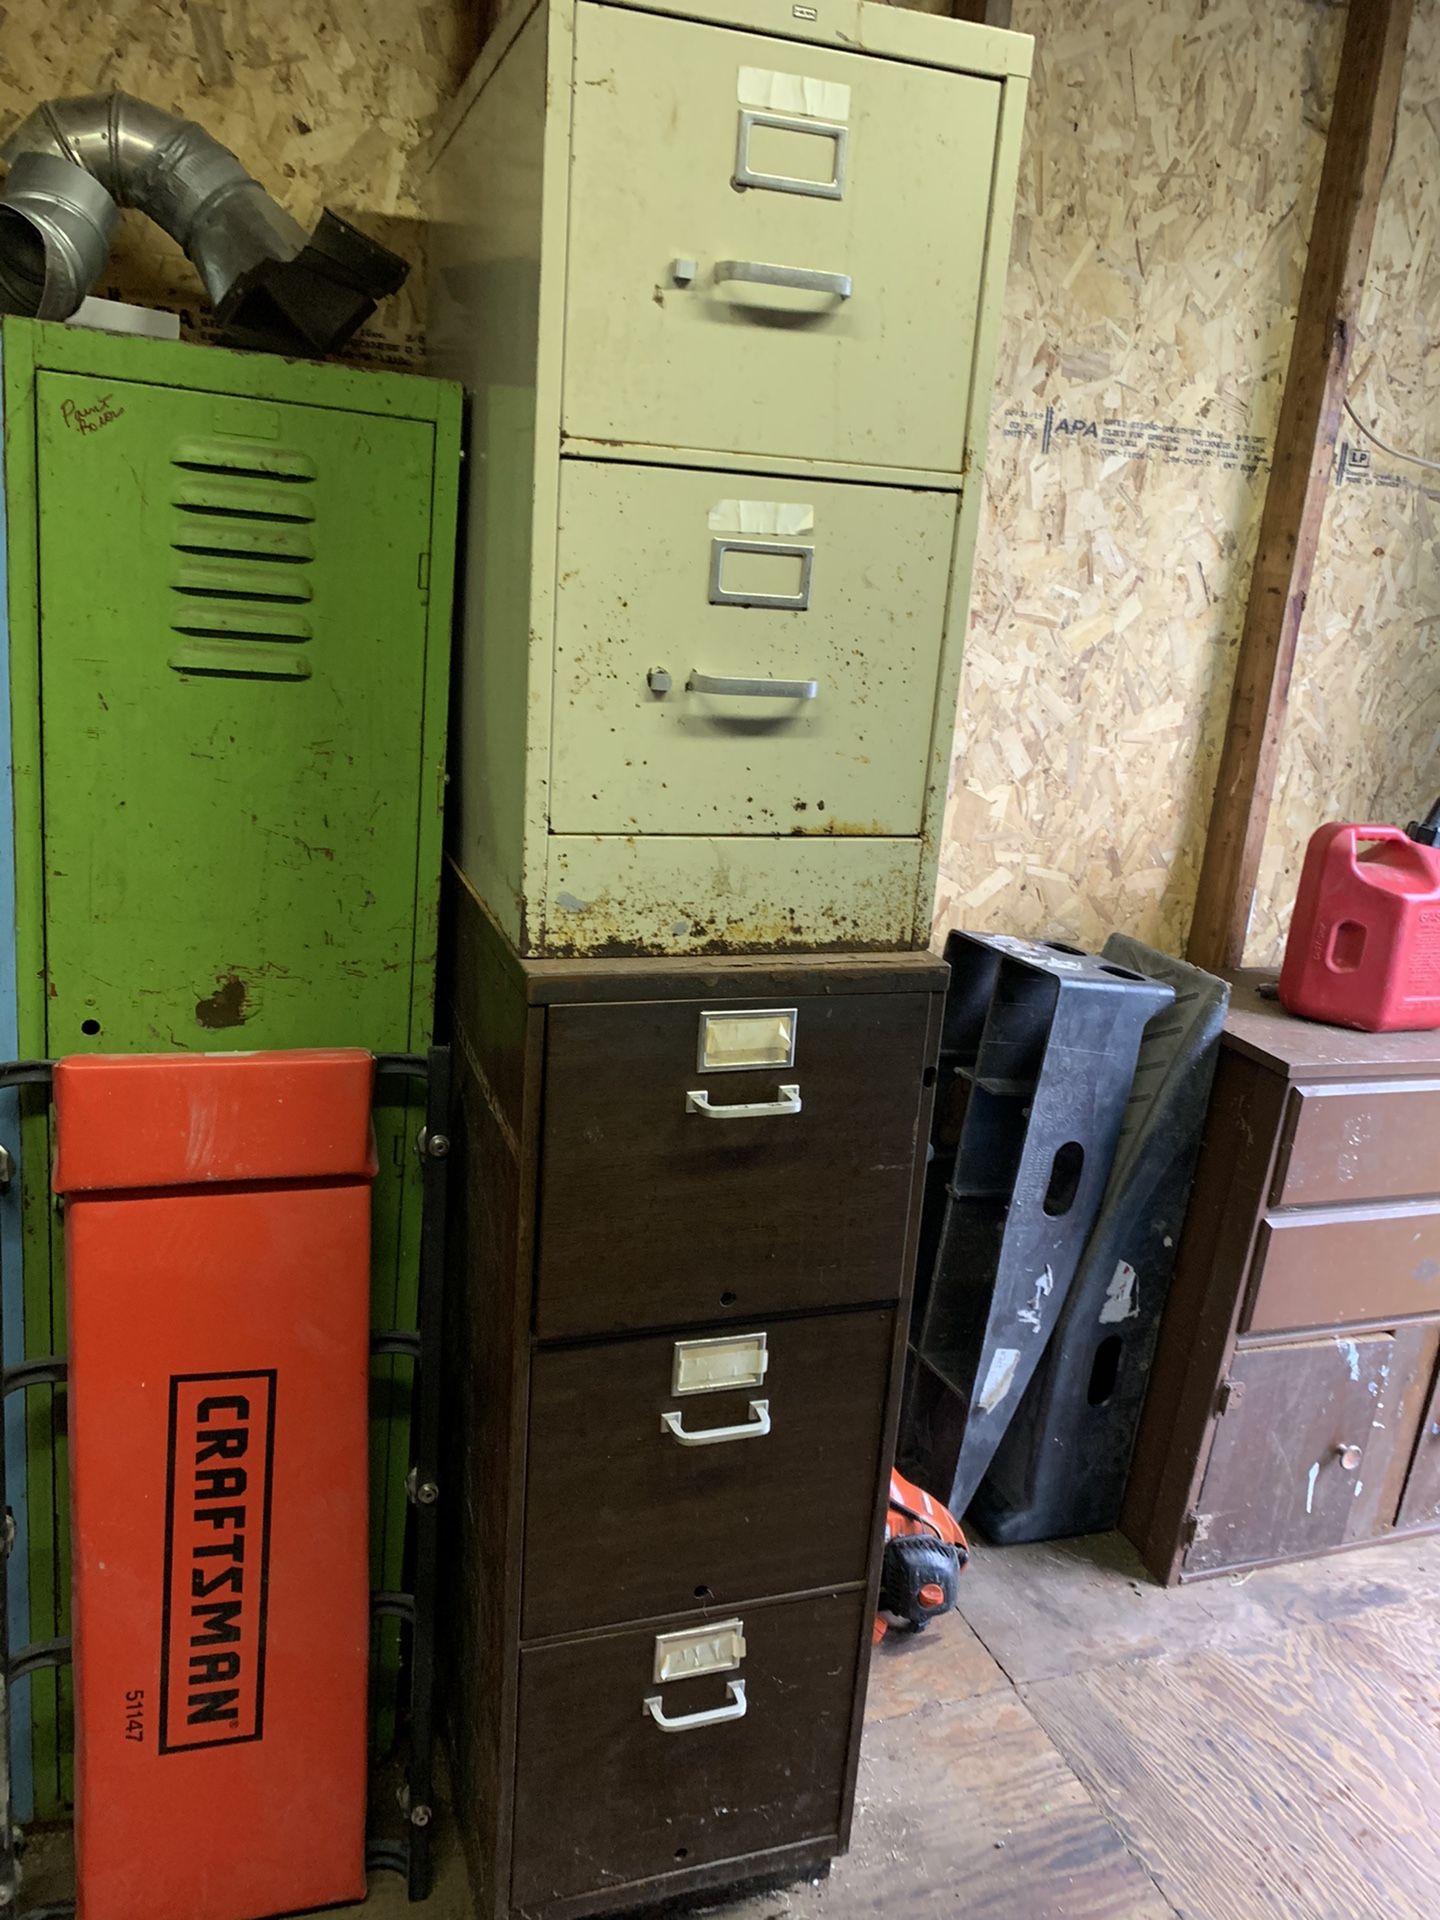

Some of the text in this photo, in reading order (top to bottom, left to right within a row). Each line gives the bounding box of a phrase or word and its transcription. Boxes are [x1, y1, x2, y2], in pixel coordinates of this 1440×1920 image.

[1054, 418, 1098, 438] APA
[1351, 452, 1367, 463] LP
[187, 1395, 250, 1726] CRAFTSMAN
[126, 1690, 144, 1742] 51147
